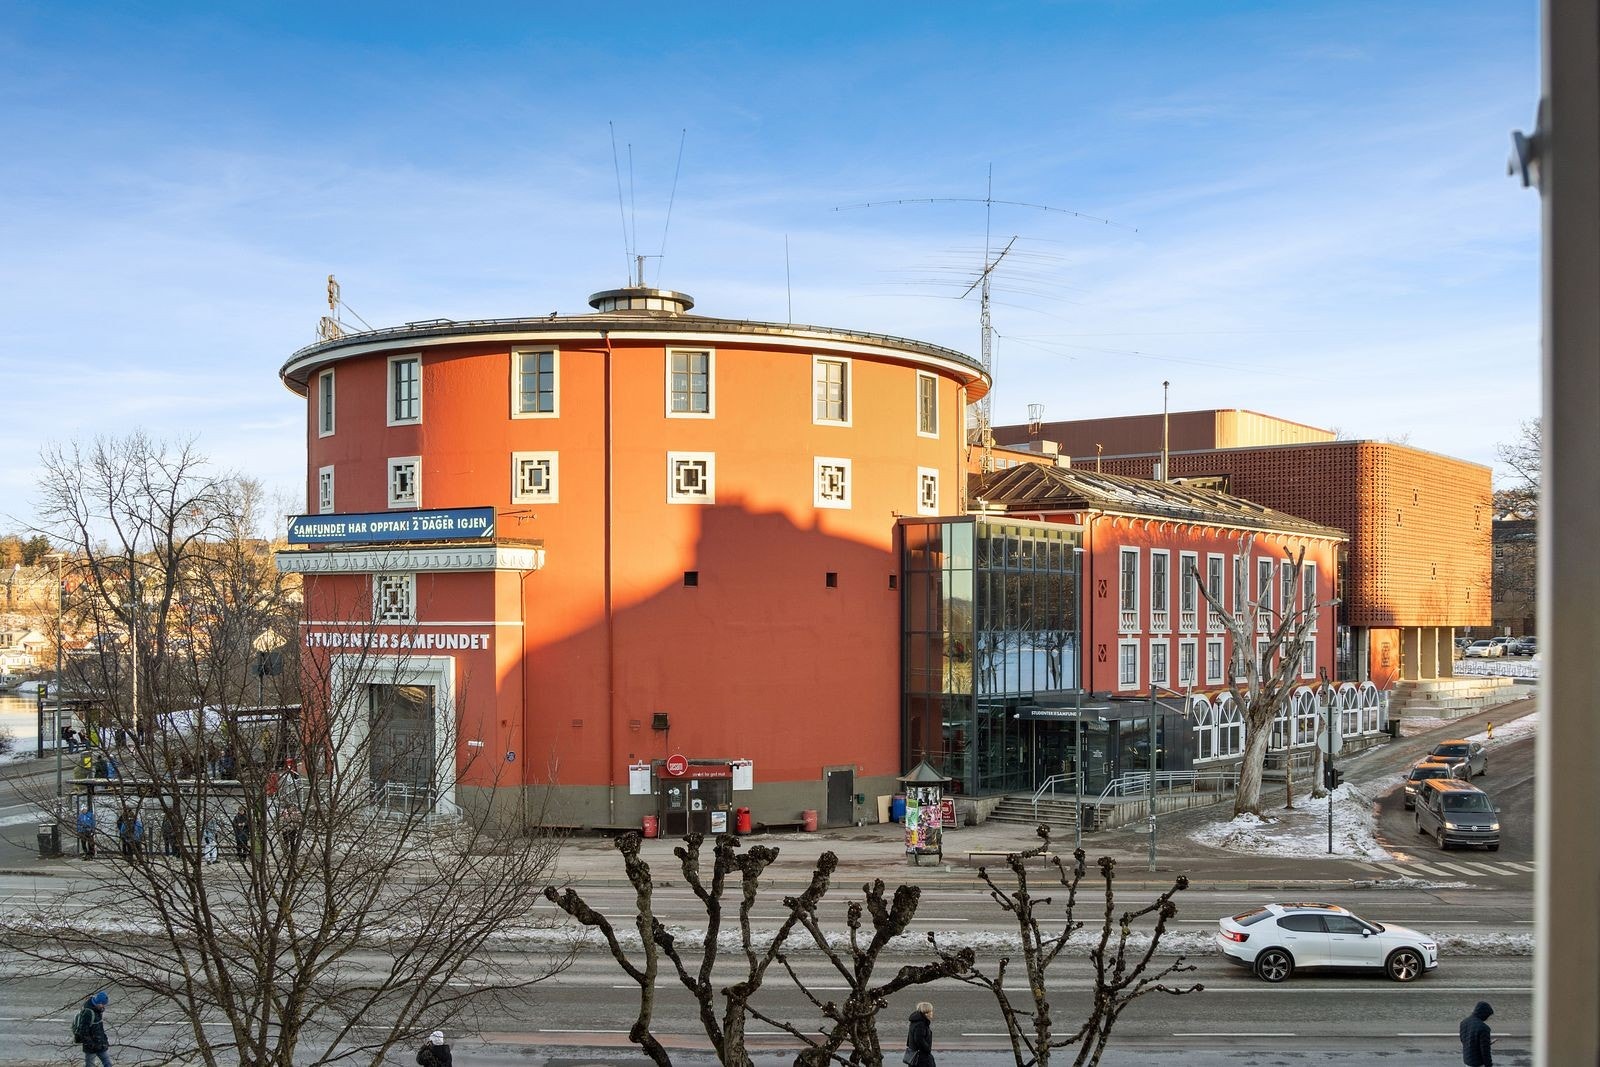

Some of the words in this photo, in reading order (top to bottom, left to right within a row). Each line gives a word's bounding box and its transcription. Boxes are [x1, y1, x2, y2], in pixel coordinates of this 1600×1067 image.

[294, 523, 346, 535] SAMFUNDET
[348, 522, 367, 533] HAR
[370, 520, 410, 533] OPPTAK!
[412, 520, 419, 531] 2
[422, 518, 454, 530] DAGER
[457, 517, 487, 529] IGJEN
[306, 632, 490, 650] STUDENTERSAMFUNDET
